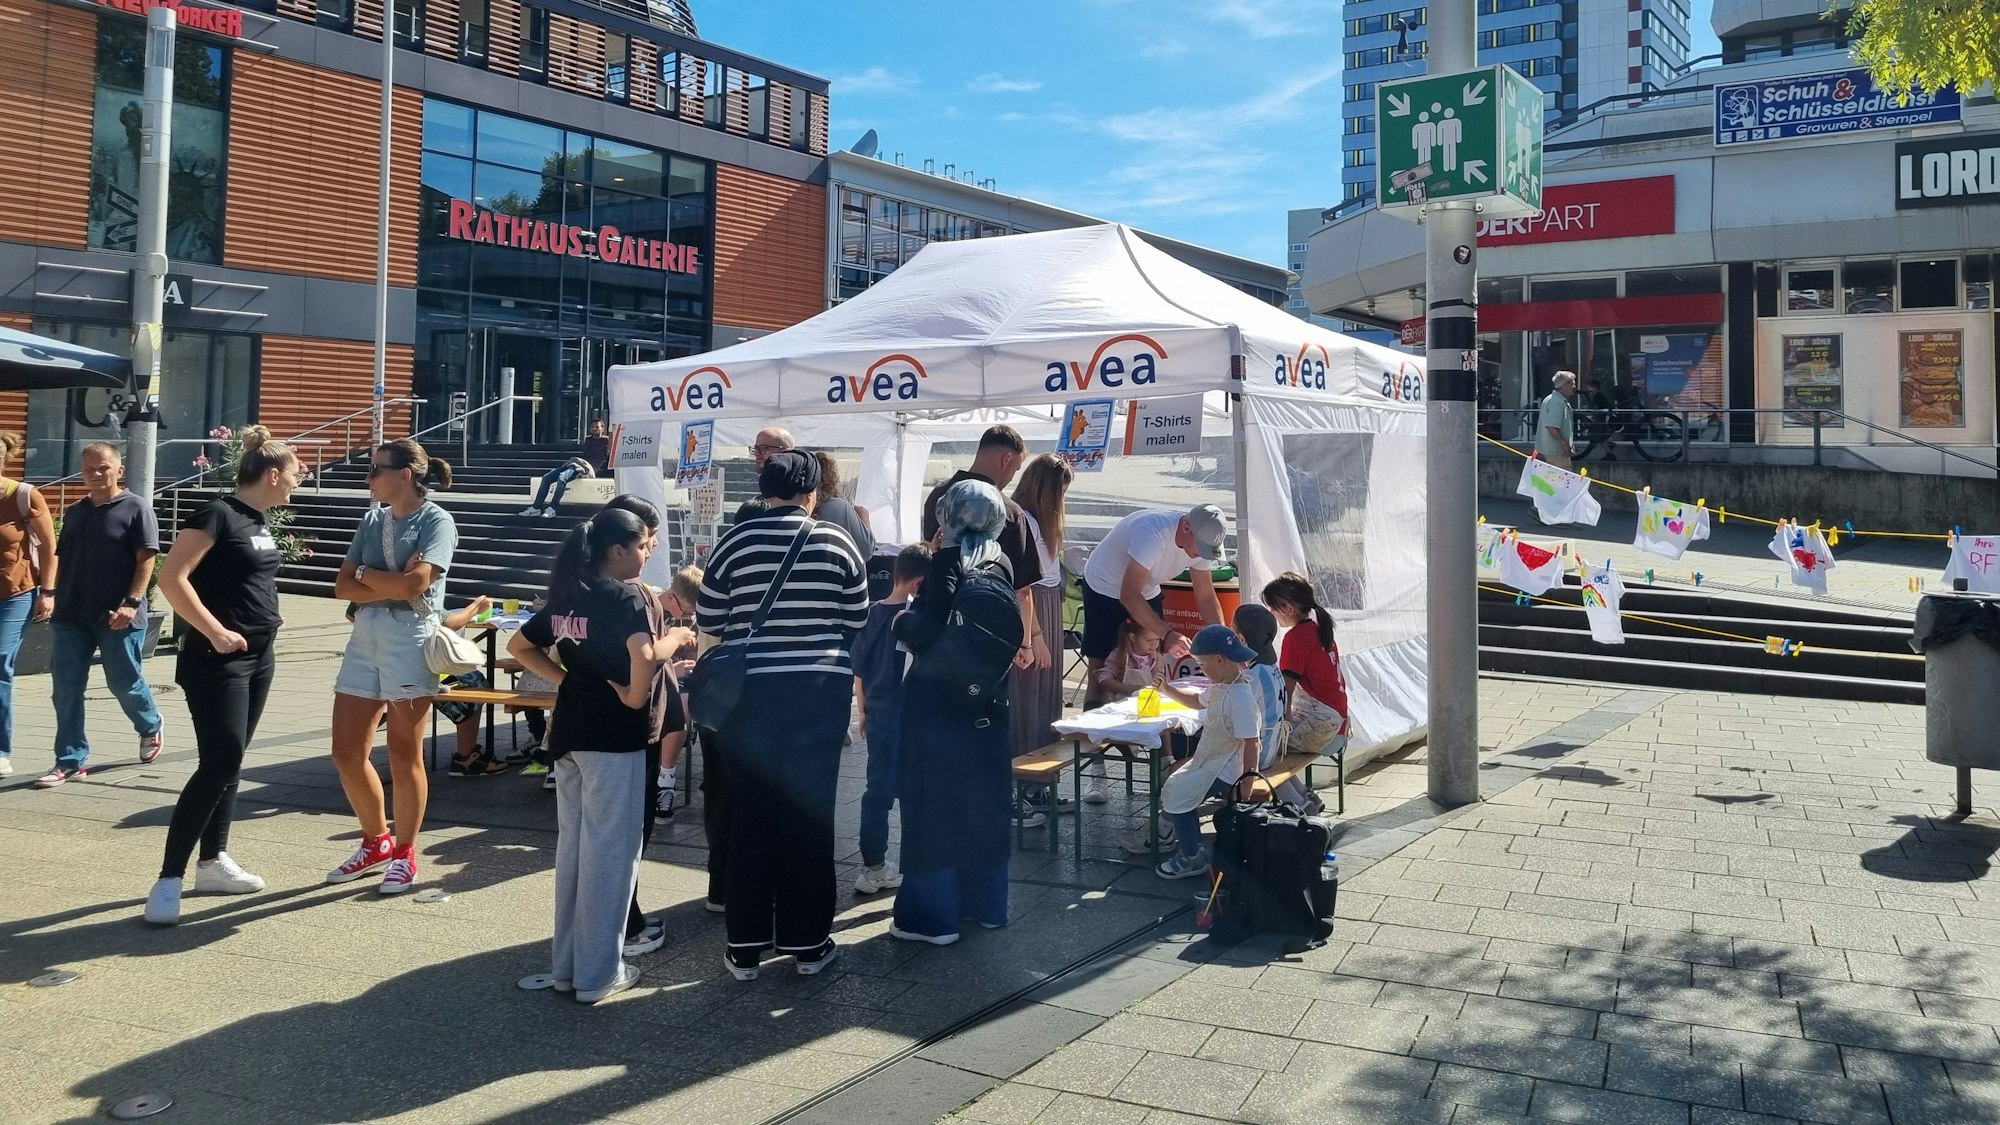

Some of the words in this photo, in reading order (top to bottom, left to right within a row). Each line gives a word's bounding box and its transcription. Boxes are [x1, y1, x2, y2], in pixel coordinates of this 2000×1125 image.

[1762, 82, 1829, 103] Schuh
[1832, 78, 1857, 101] &
[1796, 119, 1857, 134] Gravuren
[1860, 116, 1873, 129] &
[1875, 111, 1933, 126] Stempel
[450, 198, 699, 274] RATHAUS-GALERIE
[1045, 334, 1168, 392] avea
[1275, 342, 1330, 389] avea
[650, 366, 732, 412] avea
[827, 353, 928, 403] avea
[1382, 360, 1424, 401] avea
[1143, 414, 1192, 428] T-Shirts
[621, 434, 652, 445] T-Shirts
[1146, 433, 1185, 446] malen
[621, 450, 647, 460] malen
[869, 569, 891, 580] avea
